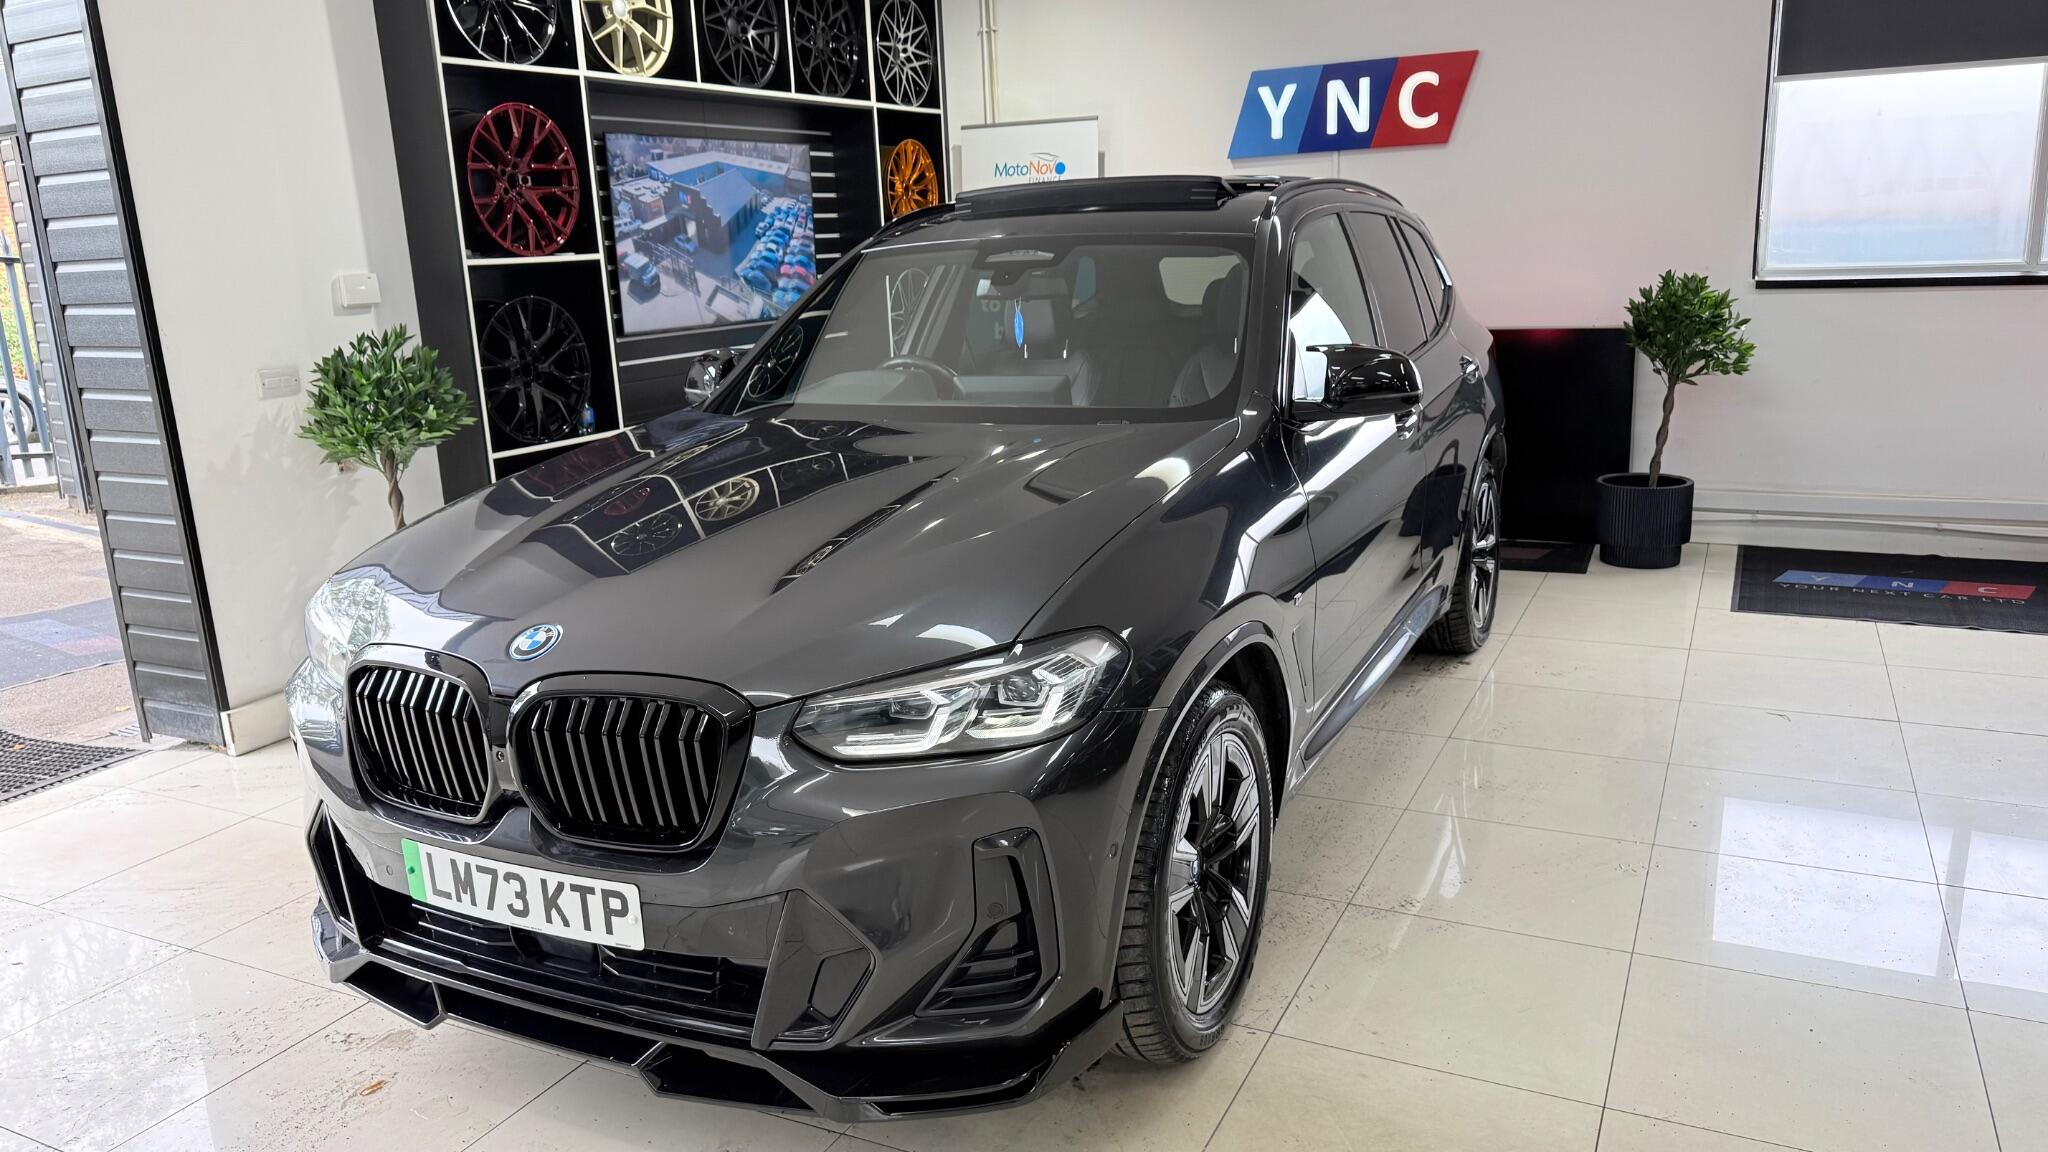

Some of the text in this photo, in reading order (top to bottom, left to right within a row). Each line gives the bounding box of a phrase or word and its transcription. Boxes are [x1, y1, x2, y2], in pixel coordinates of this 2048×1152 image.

[1257, 70, 1440, 140] YNC
[1780, 583, 1840, 591] YOUR
[1852, 587, 1911, 597] NEXT
[1923, 593, 1969, 601] CAR
[426, 851, 630, 936] LM73 KTP
